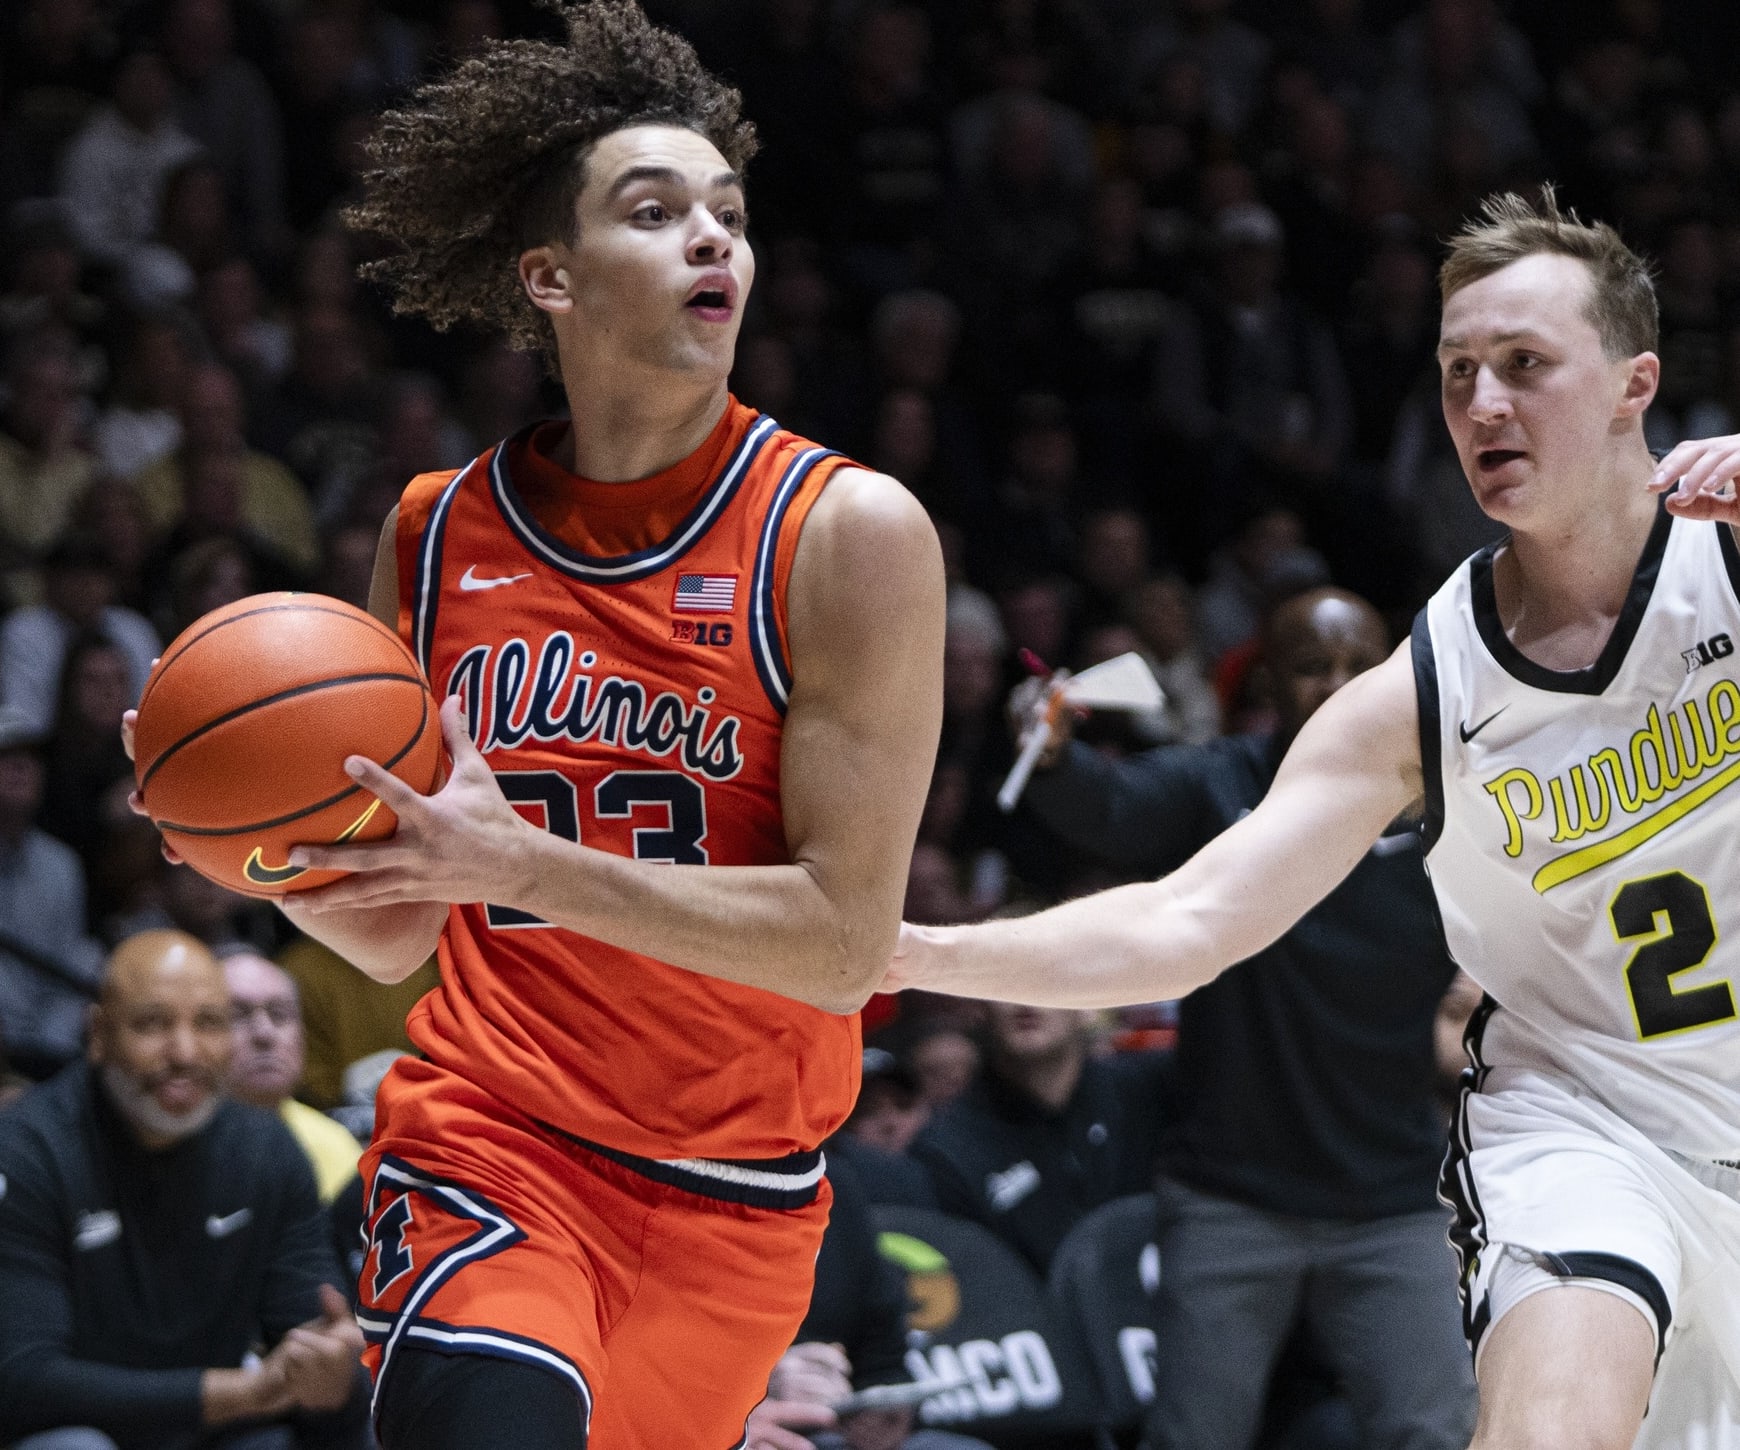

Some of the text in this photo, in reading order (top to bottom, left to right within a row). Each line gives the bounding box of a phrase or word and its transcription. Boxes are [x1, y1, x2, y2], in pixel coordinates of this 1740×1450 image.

[446, 630, 744, 781] Illinois
[1483, 679, 1740, 858] Purdue
[1610, 870, 1737, 1043] 2
